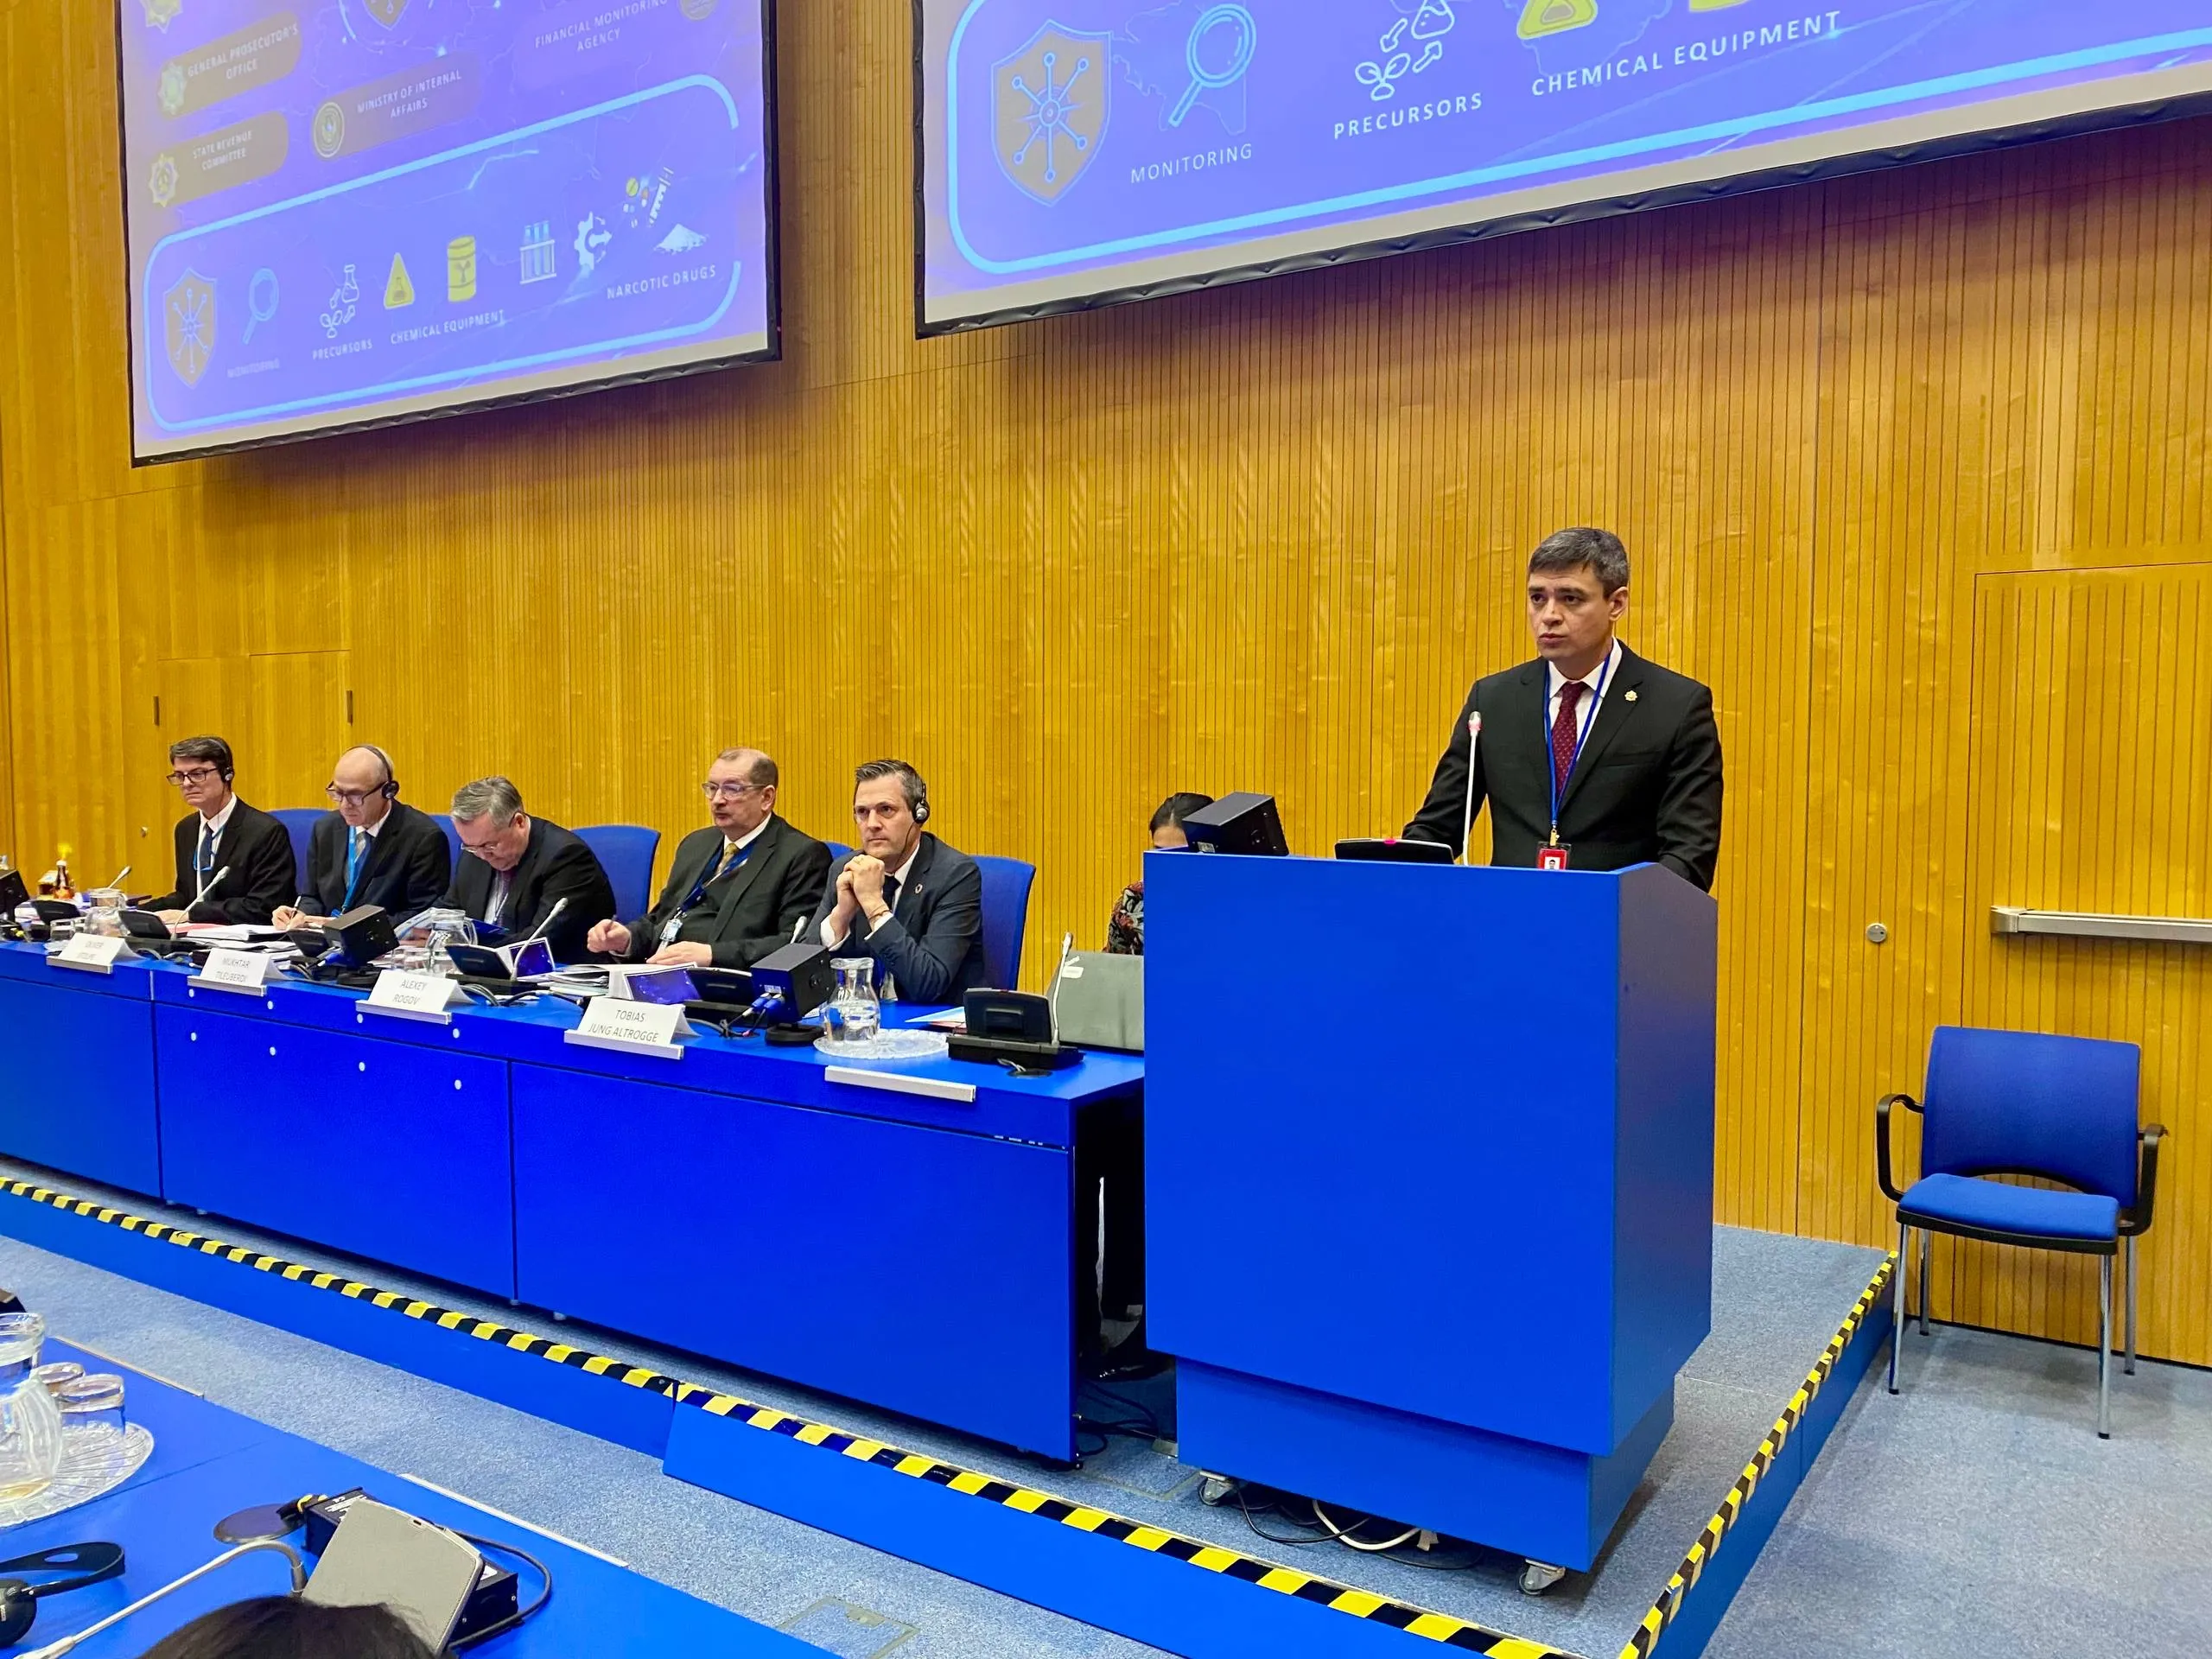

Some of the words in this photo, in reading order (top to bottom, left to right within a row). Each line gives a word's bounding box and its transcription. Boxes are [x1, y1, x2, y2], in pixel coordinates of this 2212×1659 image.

[535, 21, 591, 48] FINANCIAL
[577, 28, 621, 51] AGENCY
[188, 52, 227, 77] GENERAL
[229, 22, 299, 60] PROSECUTOR'S
[1532, 53, 1663, 97] CHEMICAL
[1674, 10, 1840, 66] EQUIPMENT
[226, 58, 257, 79] OFFICE
[357, 91, 398, 114] MINISTRY
[400, 86, 413, 99] OF
[416, 69, 461, 93] INTERNAL
[391, 98, 429, 118] AFFAIRS
[1333, 92, 1484, 140] PRECURSORS
[1130, 143, 1254, 184] MONITORING
[607, 275, 670, 300] NARCOTIC
[673, 264, 716, 286] DRUGS
[391, 325, 441, 345] CHEMICAL
[443, 309, 505, 333] EQUIPMENT
[312, 338, 373, 360] PRECURSORS
[400, 978, 429, 991] ALEXEY
[392, 994, 421, 1006] ROGOV
[615, 1009, 646, 1022] TOBIAS
[588, 1022, 613, 1036] JUNG
[613, 1027, 659, 1043] ALTROGGE
